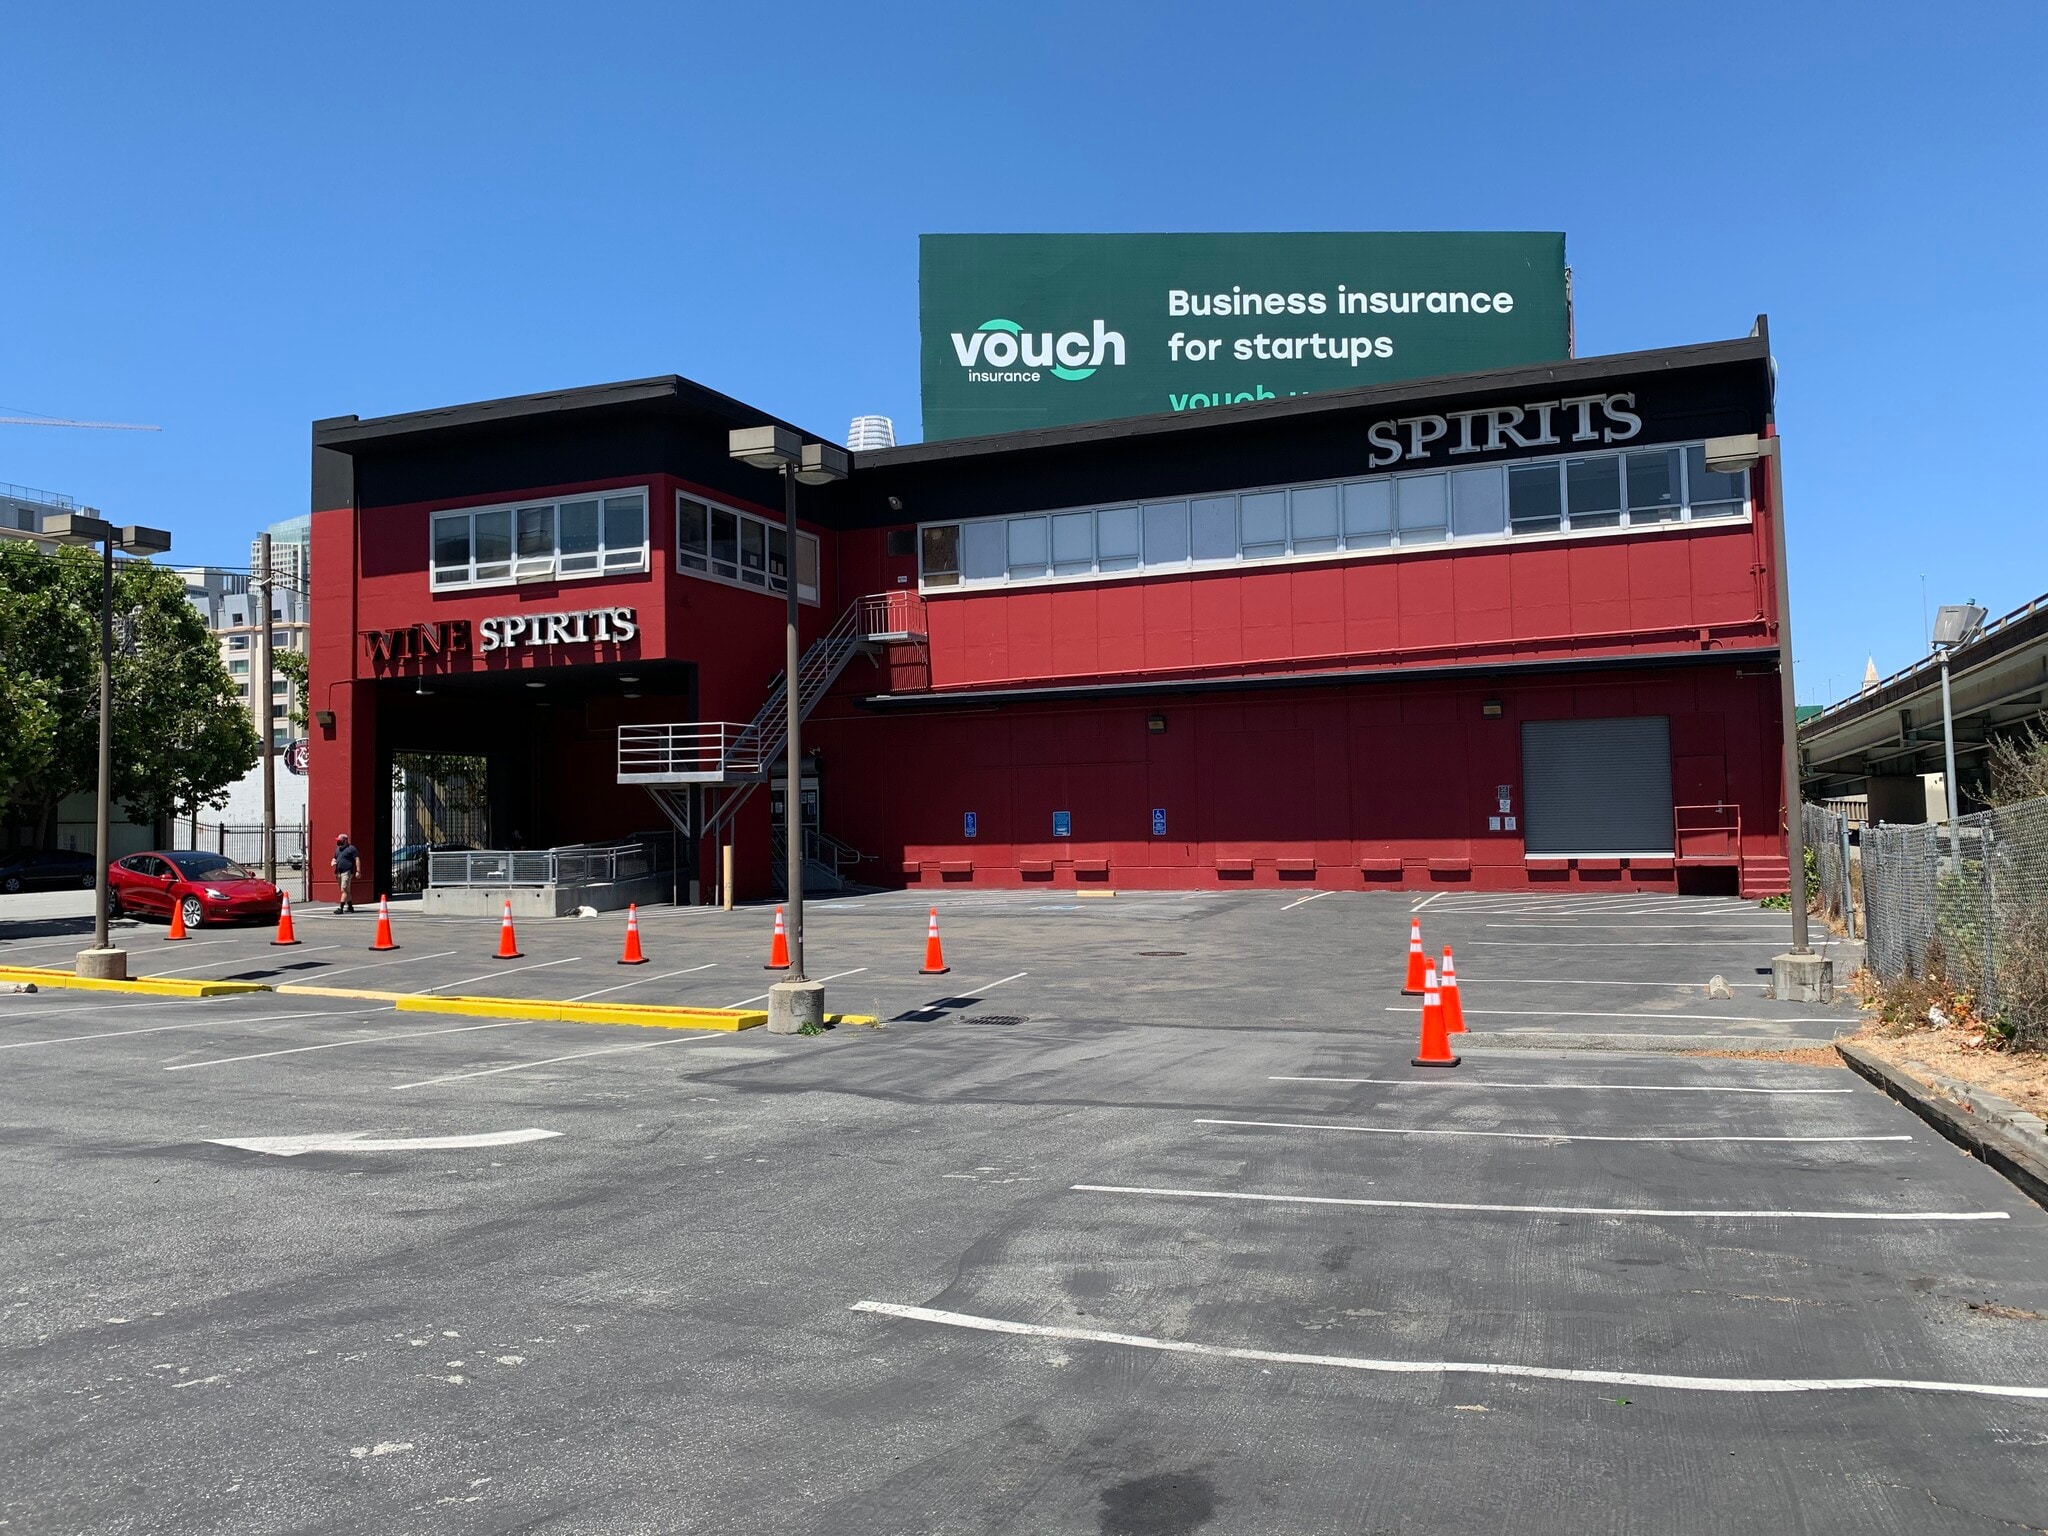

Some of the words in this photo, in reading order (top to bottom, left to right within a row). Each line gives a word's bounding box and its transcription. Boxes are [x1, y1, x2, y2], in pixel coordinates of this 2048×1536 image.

[1168, 285, 1328, 316] Business
[1338, 284, 1514, 314] insurance
[950, 319, 1126, 367] vouch
[1168, 332, 1222, 361] for
[1233, 333, 1394, 367] startups
[968, 369, 1041, 382] insurance
[1367, 391, 1643, 468] SPIRITS
[359, 620, 471, 662] WINE
[479, 607, 637, 652] SPIRITS
